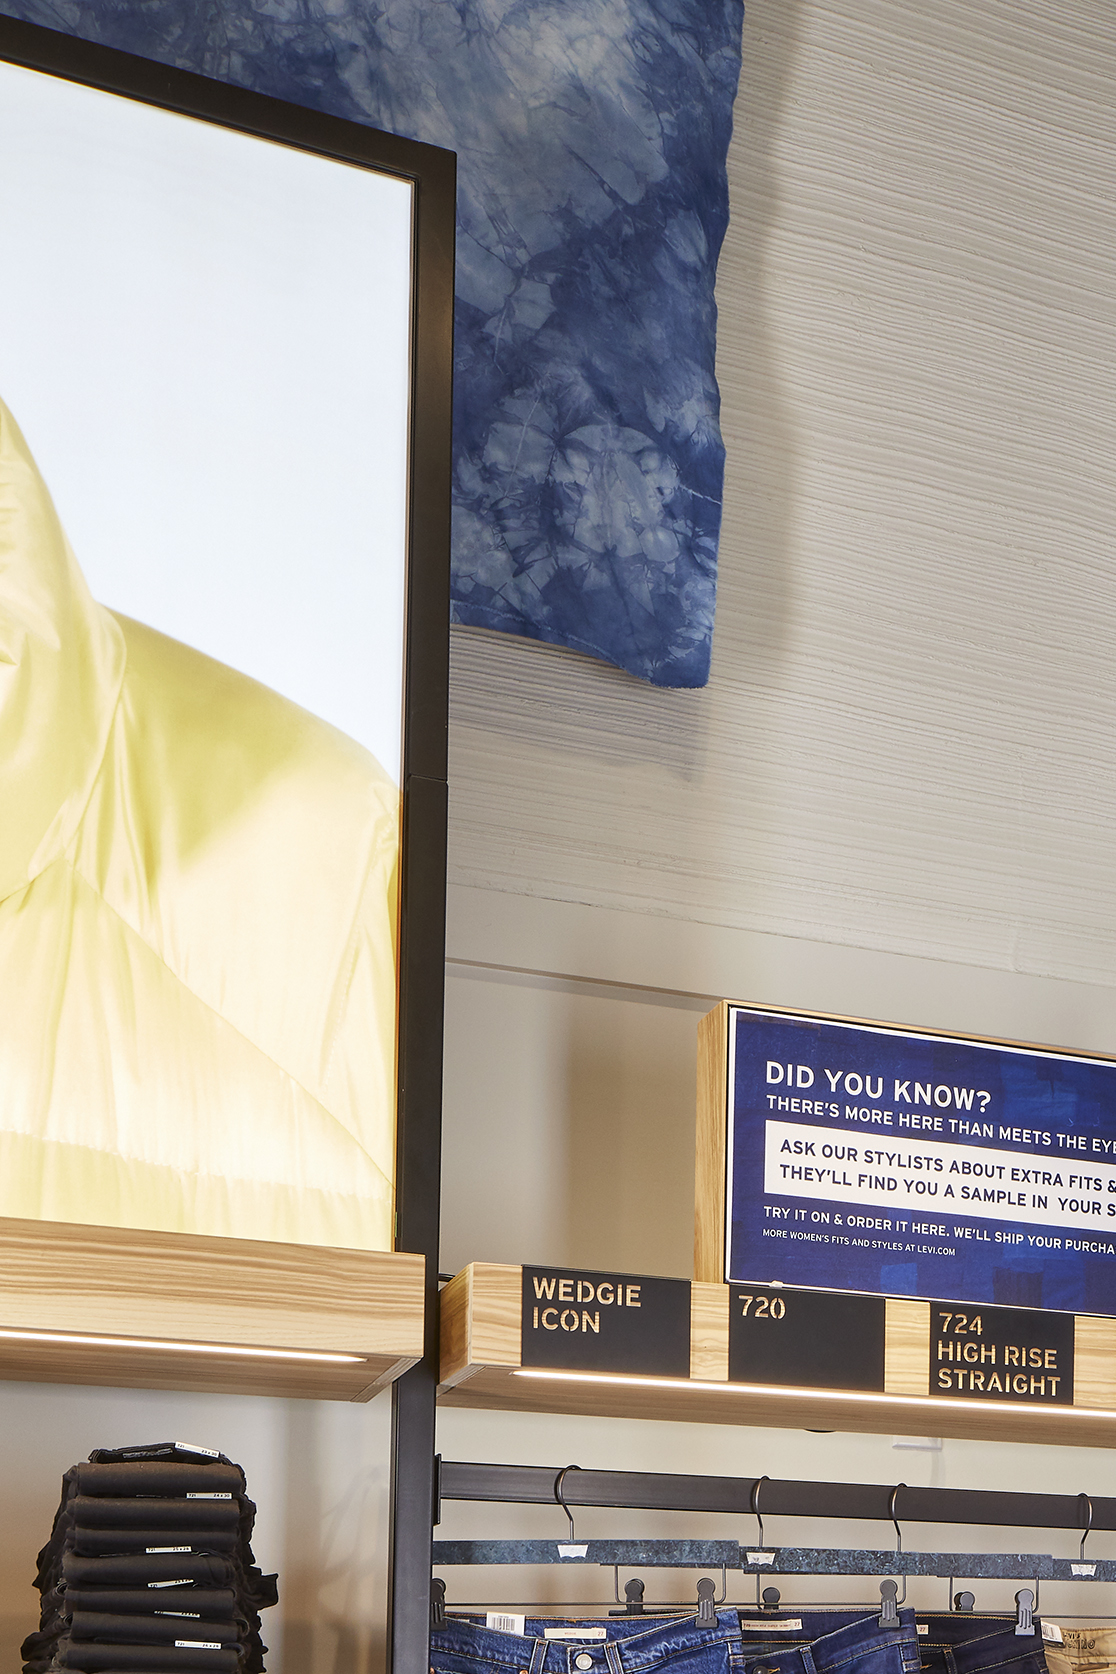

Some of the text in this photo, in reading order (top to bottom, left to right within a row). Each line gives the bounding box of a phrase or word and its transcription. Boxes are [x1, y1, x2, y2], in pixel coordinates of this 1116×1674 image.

[765, 1061, 992, 1113] DID YOU KNOW?
[766, 1095, 840, 1118] THERE'S
[846, 1106, 893, 1125] MORE
[899, 1113, 943, 1131] HERE
[949, 1119, 994, 1138] THAN
[1000, 1126, 1051, 1145] MEETS
[1057, 1134, 1087, 1150] THE
[780, 1139, 816, 1156] ASK
[822, 1144, 858, 1161] OUR
[864, 1150, 943, 1172] STYLISTS
[949, 1160, 1006, 1179] ABOUT
[1011, 1168, 1063, 1187] EXTRA
[1069, 1175, 1102, 1191] FITS
[780, 1164, 852, 1186] THEY'LL
[858, 1174, 897, 1191] FIND
[903, 1179, 938, 1196] YOU
[944, 1184, 955, 1198] A
[961, 1186, 1026, 1206] SAMPLE
[1032, 1195, 1048, 1209] IN
[1058, 1197, 1101, 1215] YOUR
[764, 1206, 790, 1220] TRY
[794, 1209, 807, 1221] IT
[811, 1211, 830, 1224] ON
[834, 1214, 843, 1225] &
[847, 1215, 892, 1231] ORDER
[896, 1221, 908, 1232] IT
[912, 1222, 950, 1237] HERE.
[954, 1226, 991, 1241] WE'LL
[994, 1232, 1024, 1245] SHIP
[1028, 1235, 1061, 1249] YOUR
[763, 1229, 956, 1256] MORE WOMEN'S FITS AND STYLES AT LEVI.COM
[532, 1277, 641, 1307] WEDGIE
[533, 1306, 599, 1333] ICON
[738, 1295, 786, 1319] 720
[939, 1312, 983, 1336] 724
[937, 1340, 1057, 1369] HIGH RISE
[938, 1368, 1061, 1396] STRAIGHT
